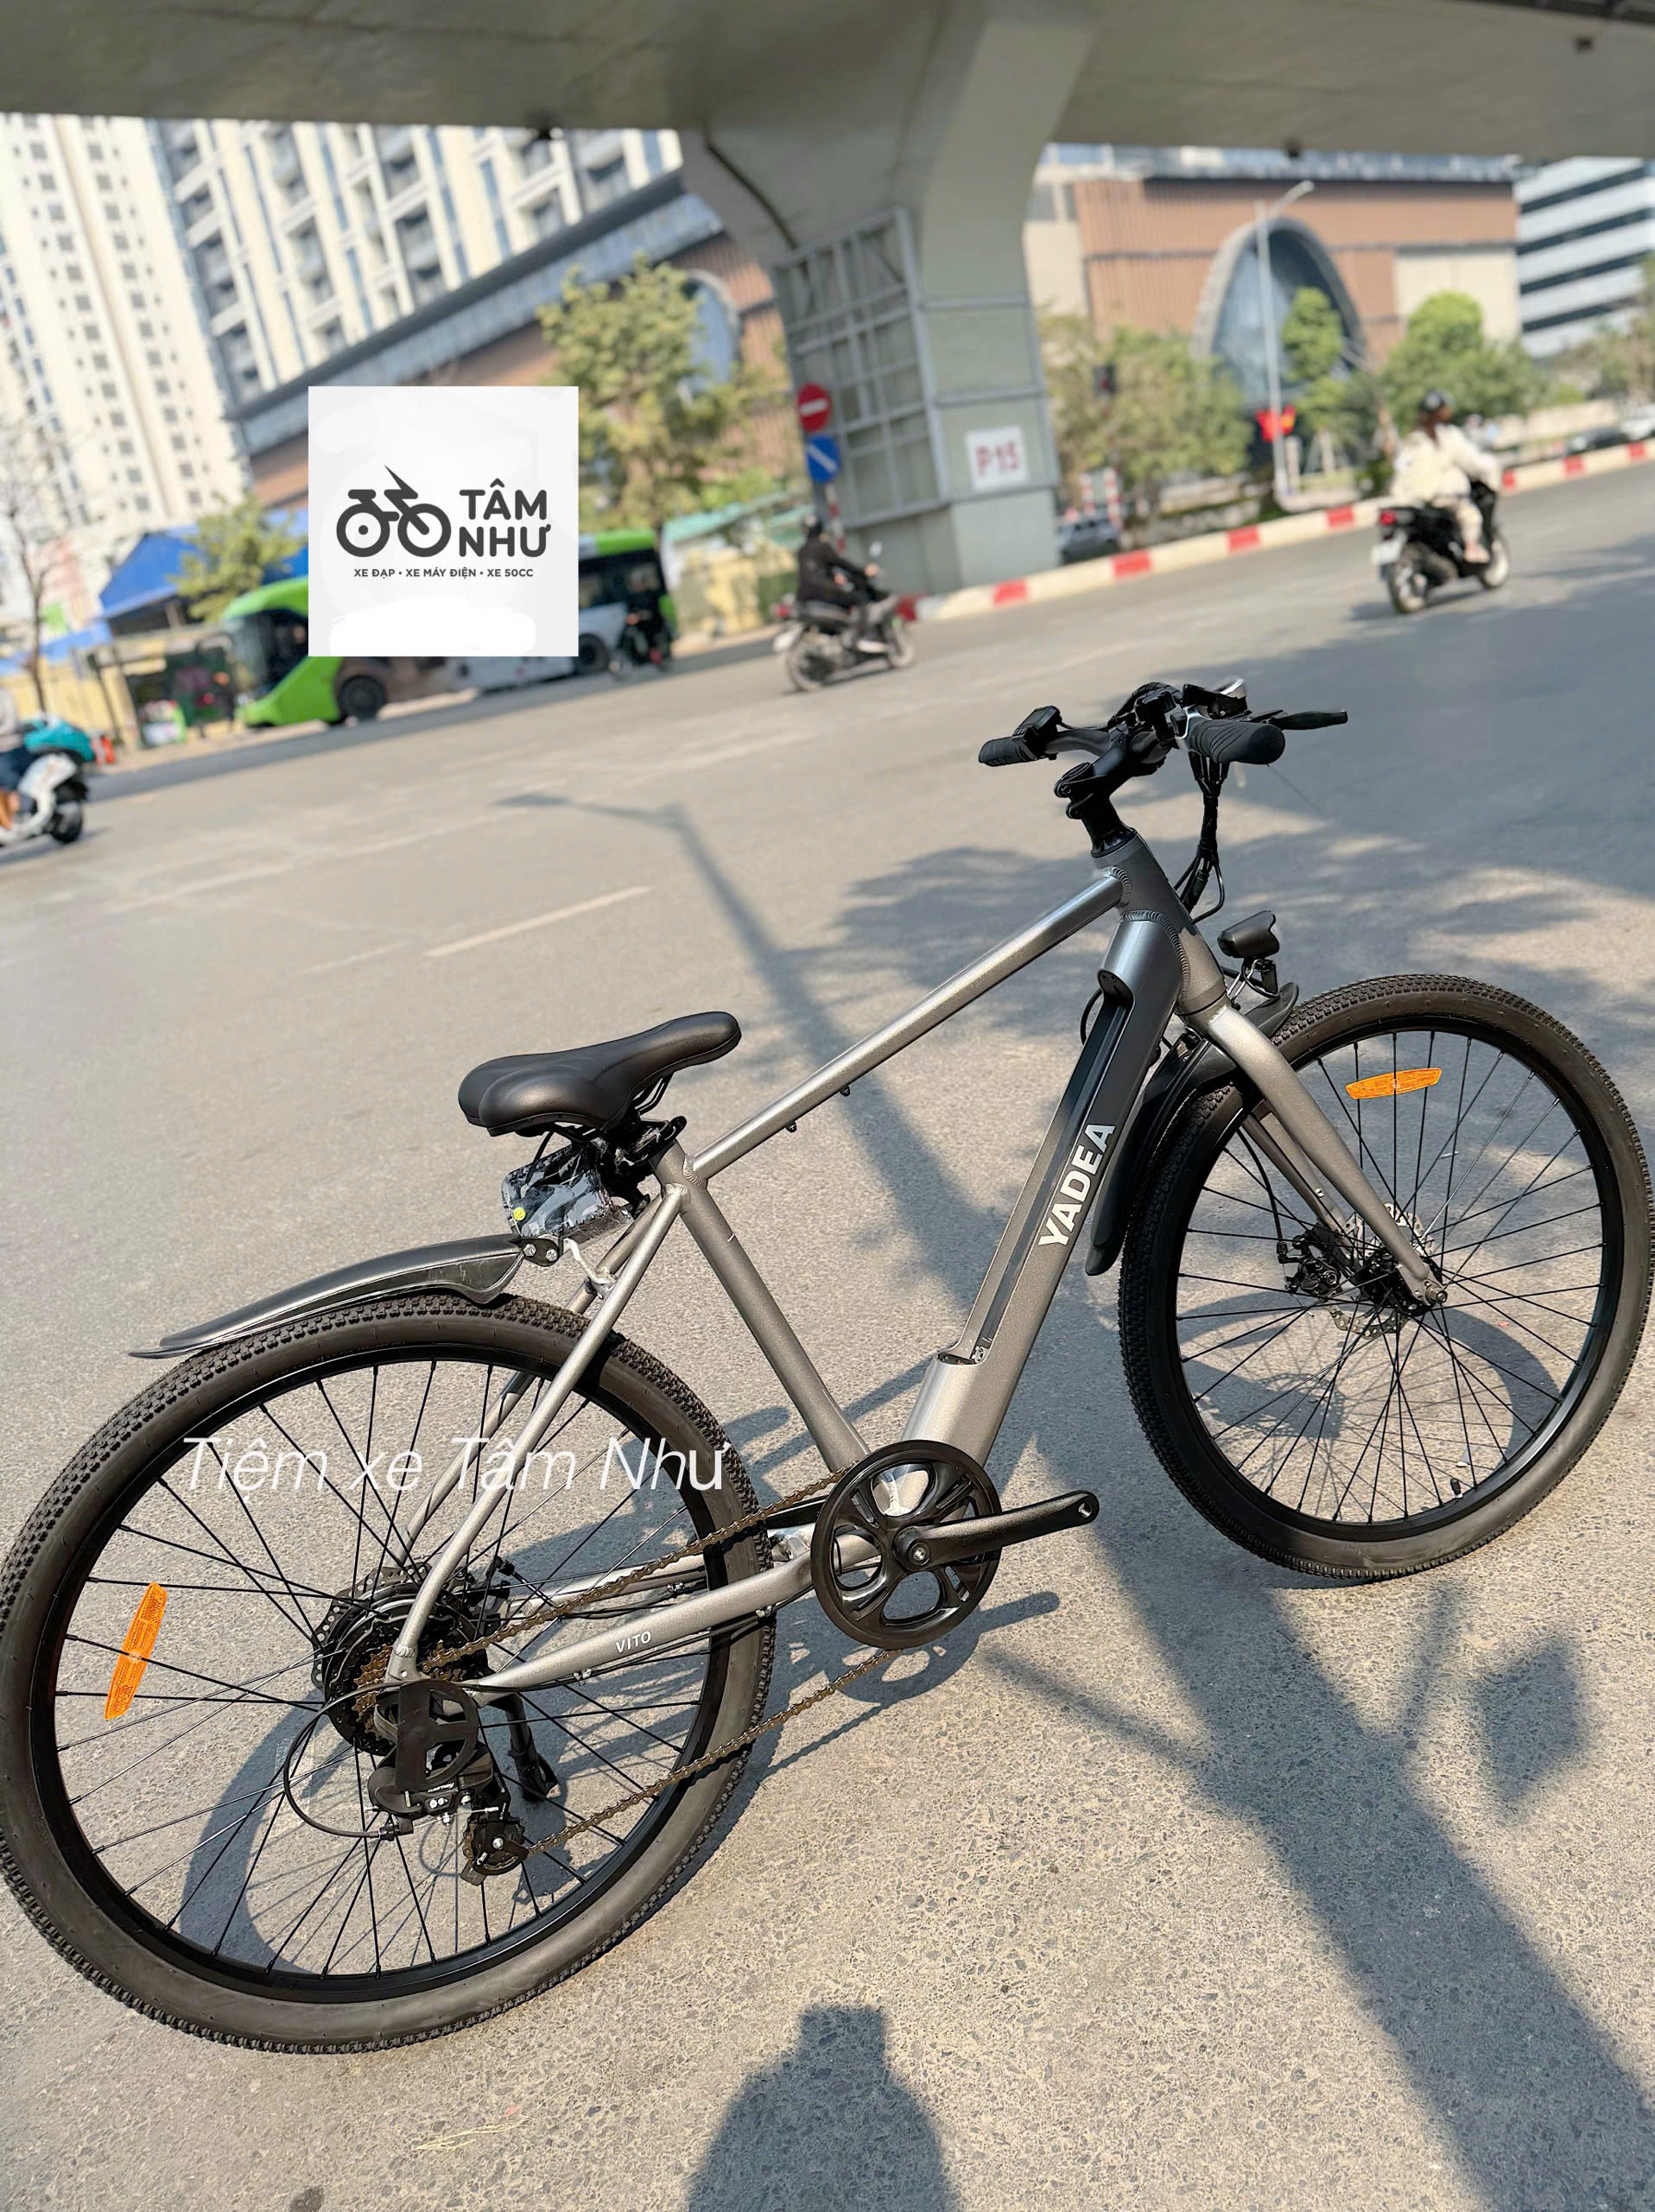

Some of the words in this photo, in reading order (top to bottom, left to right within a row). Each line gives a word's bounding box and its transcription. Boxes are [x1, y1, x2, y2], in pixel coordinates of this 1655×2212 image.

[975, 440, 1019, 477] P15
[1037, 1124, 1116, 1246] YADEA
[615, 1630, 652, 1653] VITO
